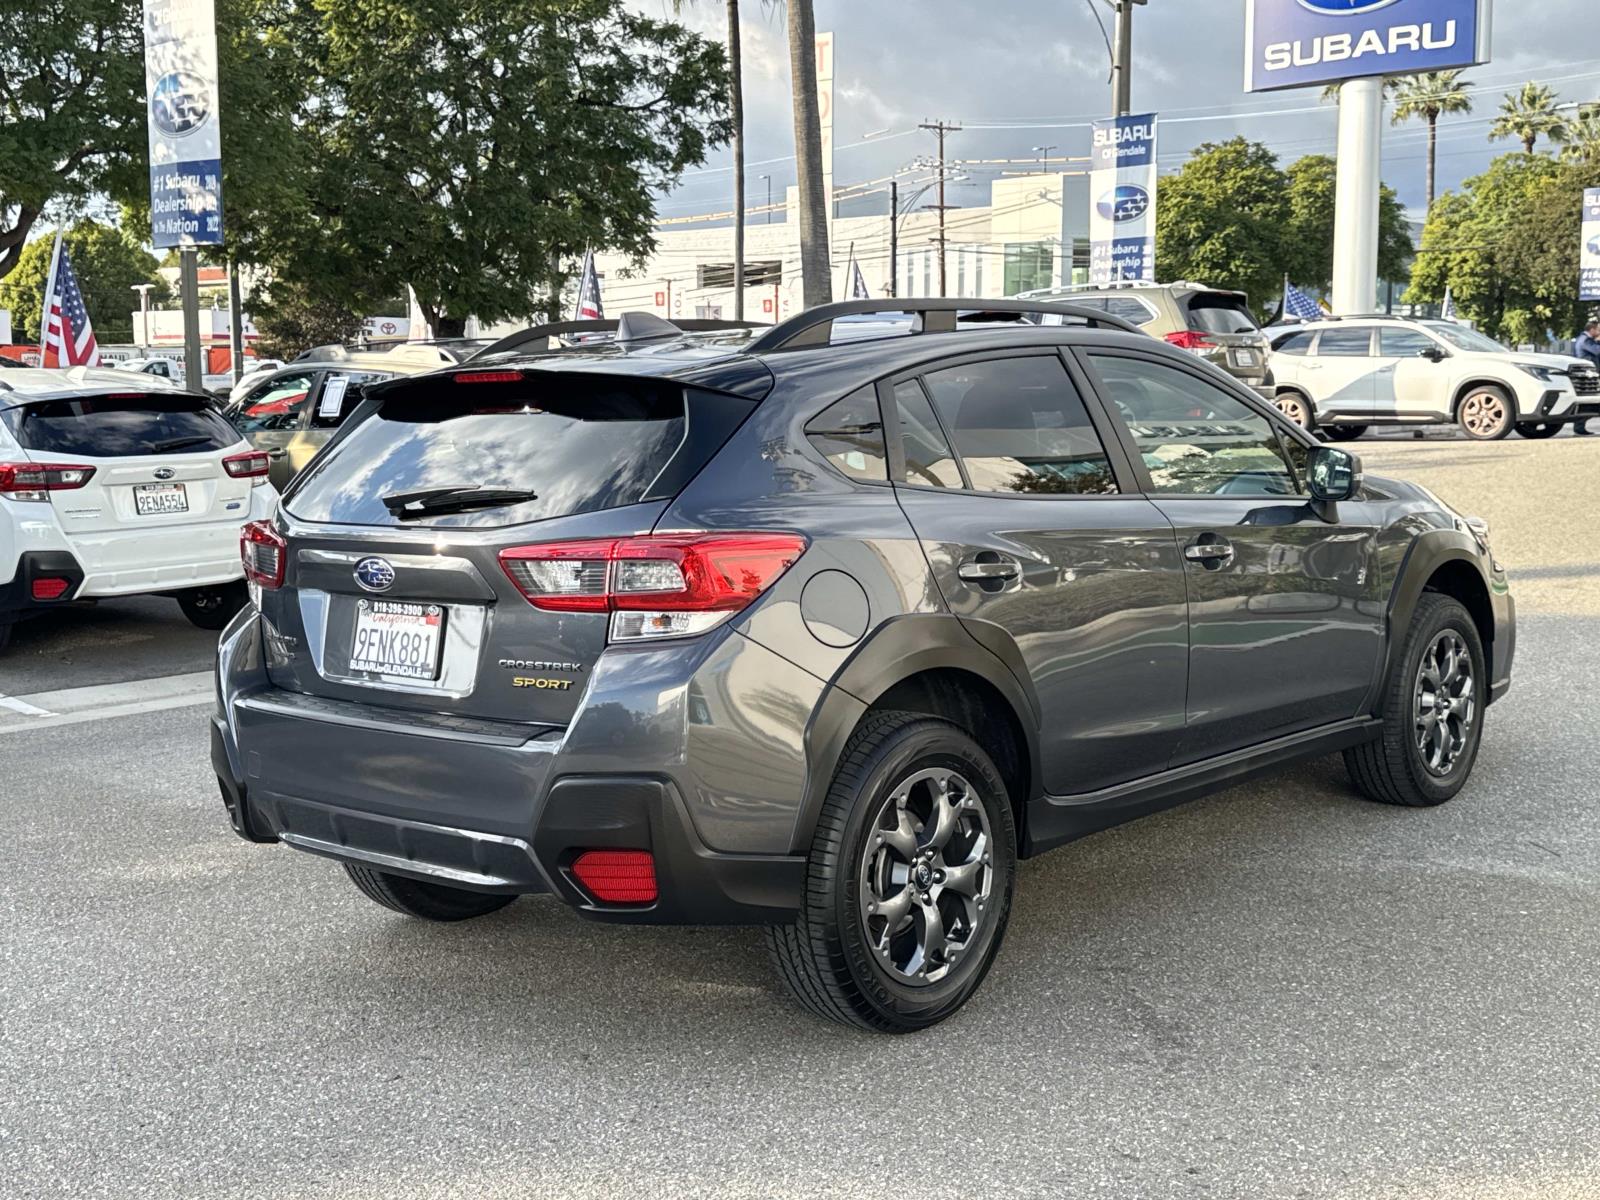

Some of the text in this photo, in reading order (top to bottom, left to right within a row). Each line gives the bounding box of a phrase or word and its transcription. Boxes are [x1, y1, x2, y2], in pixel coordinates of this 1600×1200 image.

[1264, 19, 1456, 71] SUBARU
[1093, 123, 1155, 147] SUBARU
[153, 172, 200, 192] #1 Subaru
[154, 193, 204, 214] Dealership
[166, 216, 199, 234] Nation
[1106, 244, 1139, 257] Subaru
[373, 602, 423, 616] 818-396-3900
[355, 627, 431, 665] 9FNK881
[349, 659, 380, 673] SUBARU
[498, 658, 583, 672] CROSSTREK
[512, 676, 573, 691] SPORT
